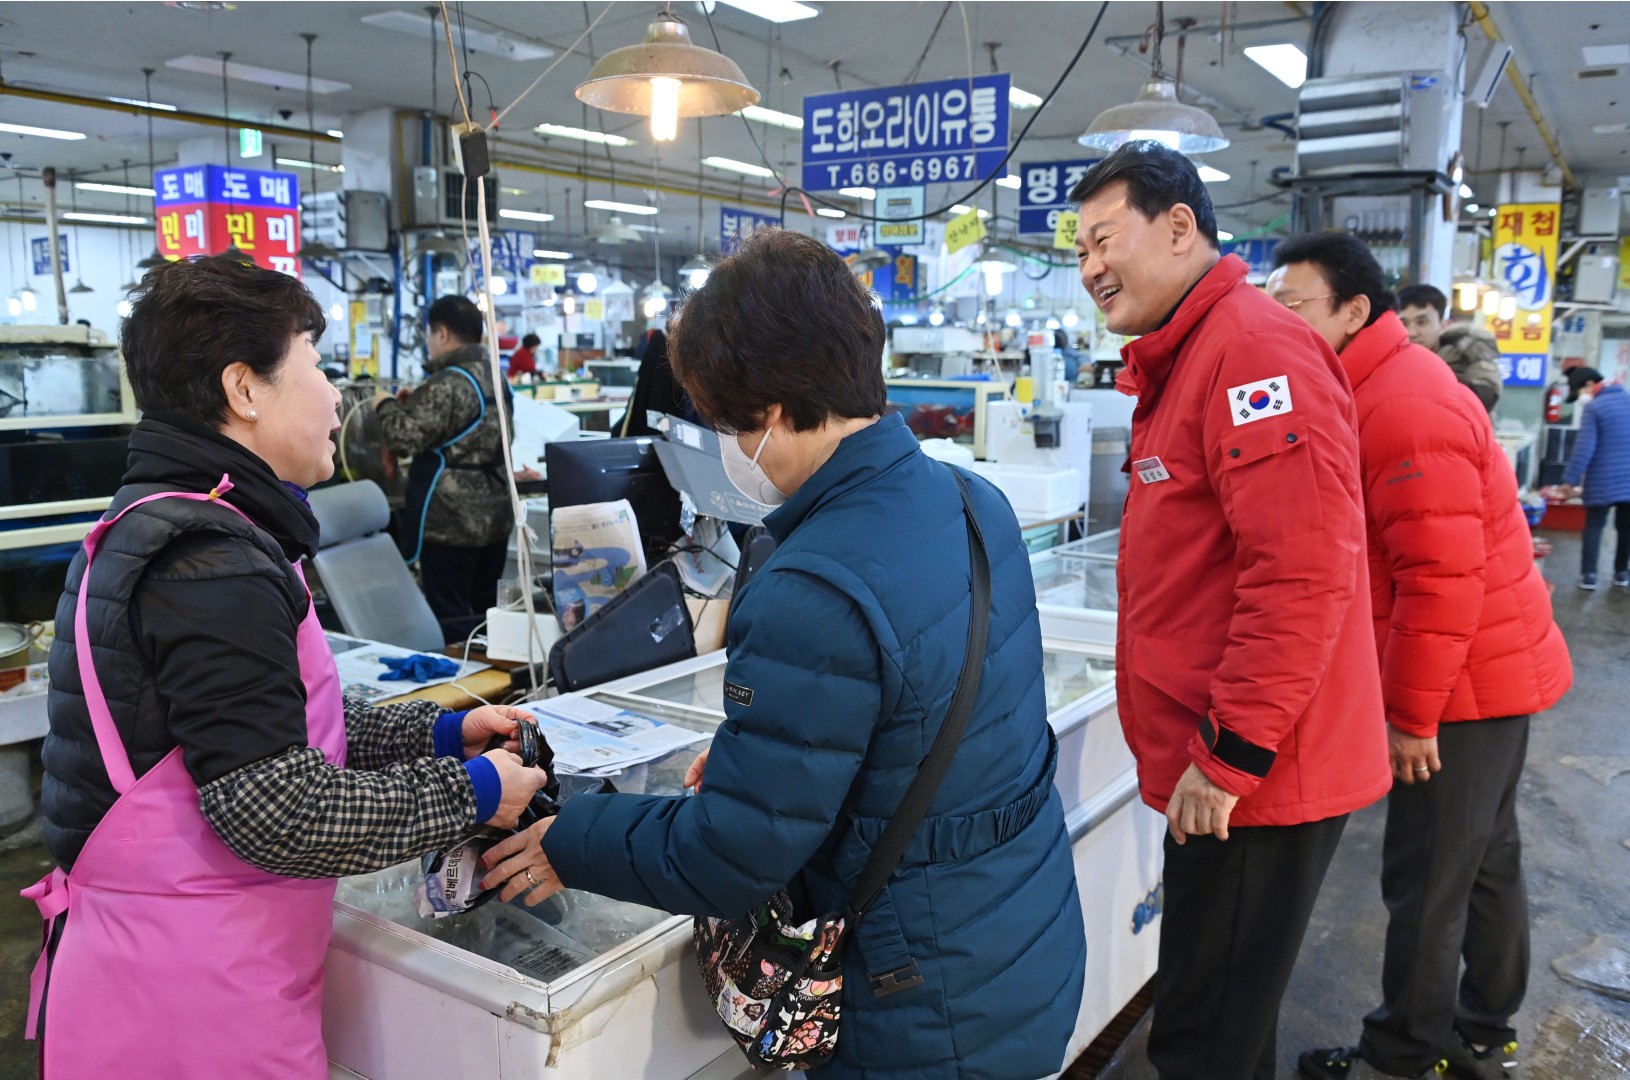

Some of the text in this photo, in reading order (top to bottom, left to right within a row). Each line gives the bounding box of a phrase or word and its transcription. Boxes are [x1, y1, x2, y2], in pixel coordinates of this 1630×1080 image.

[811, 87, 997, 154] 도희오라이유통
[161, 170, 206, 200] 도매
[827, 154, 976, 187] T.666-6967
[221, 171, 291, 206] 도매
